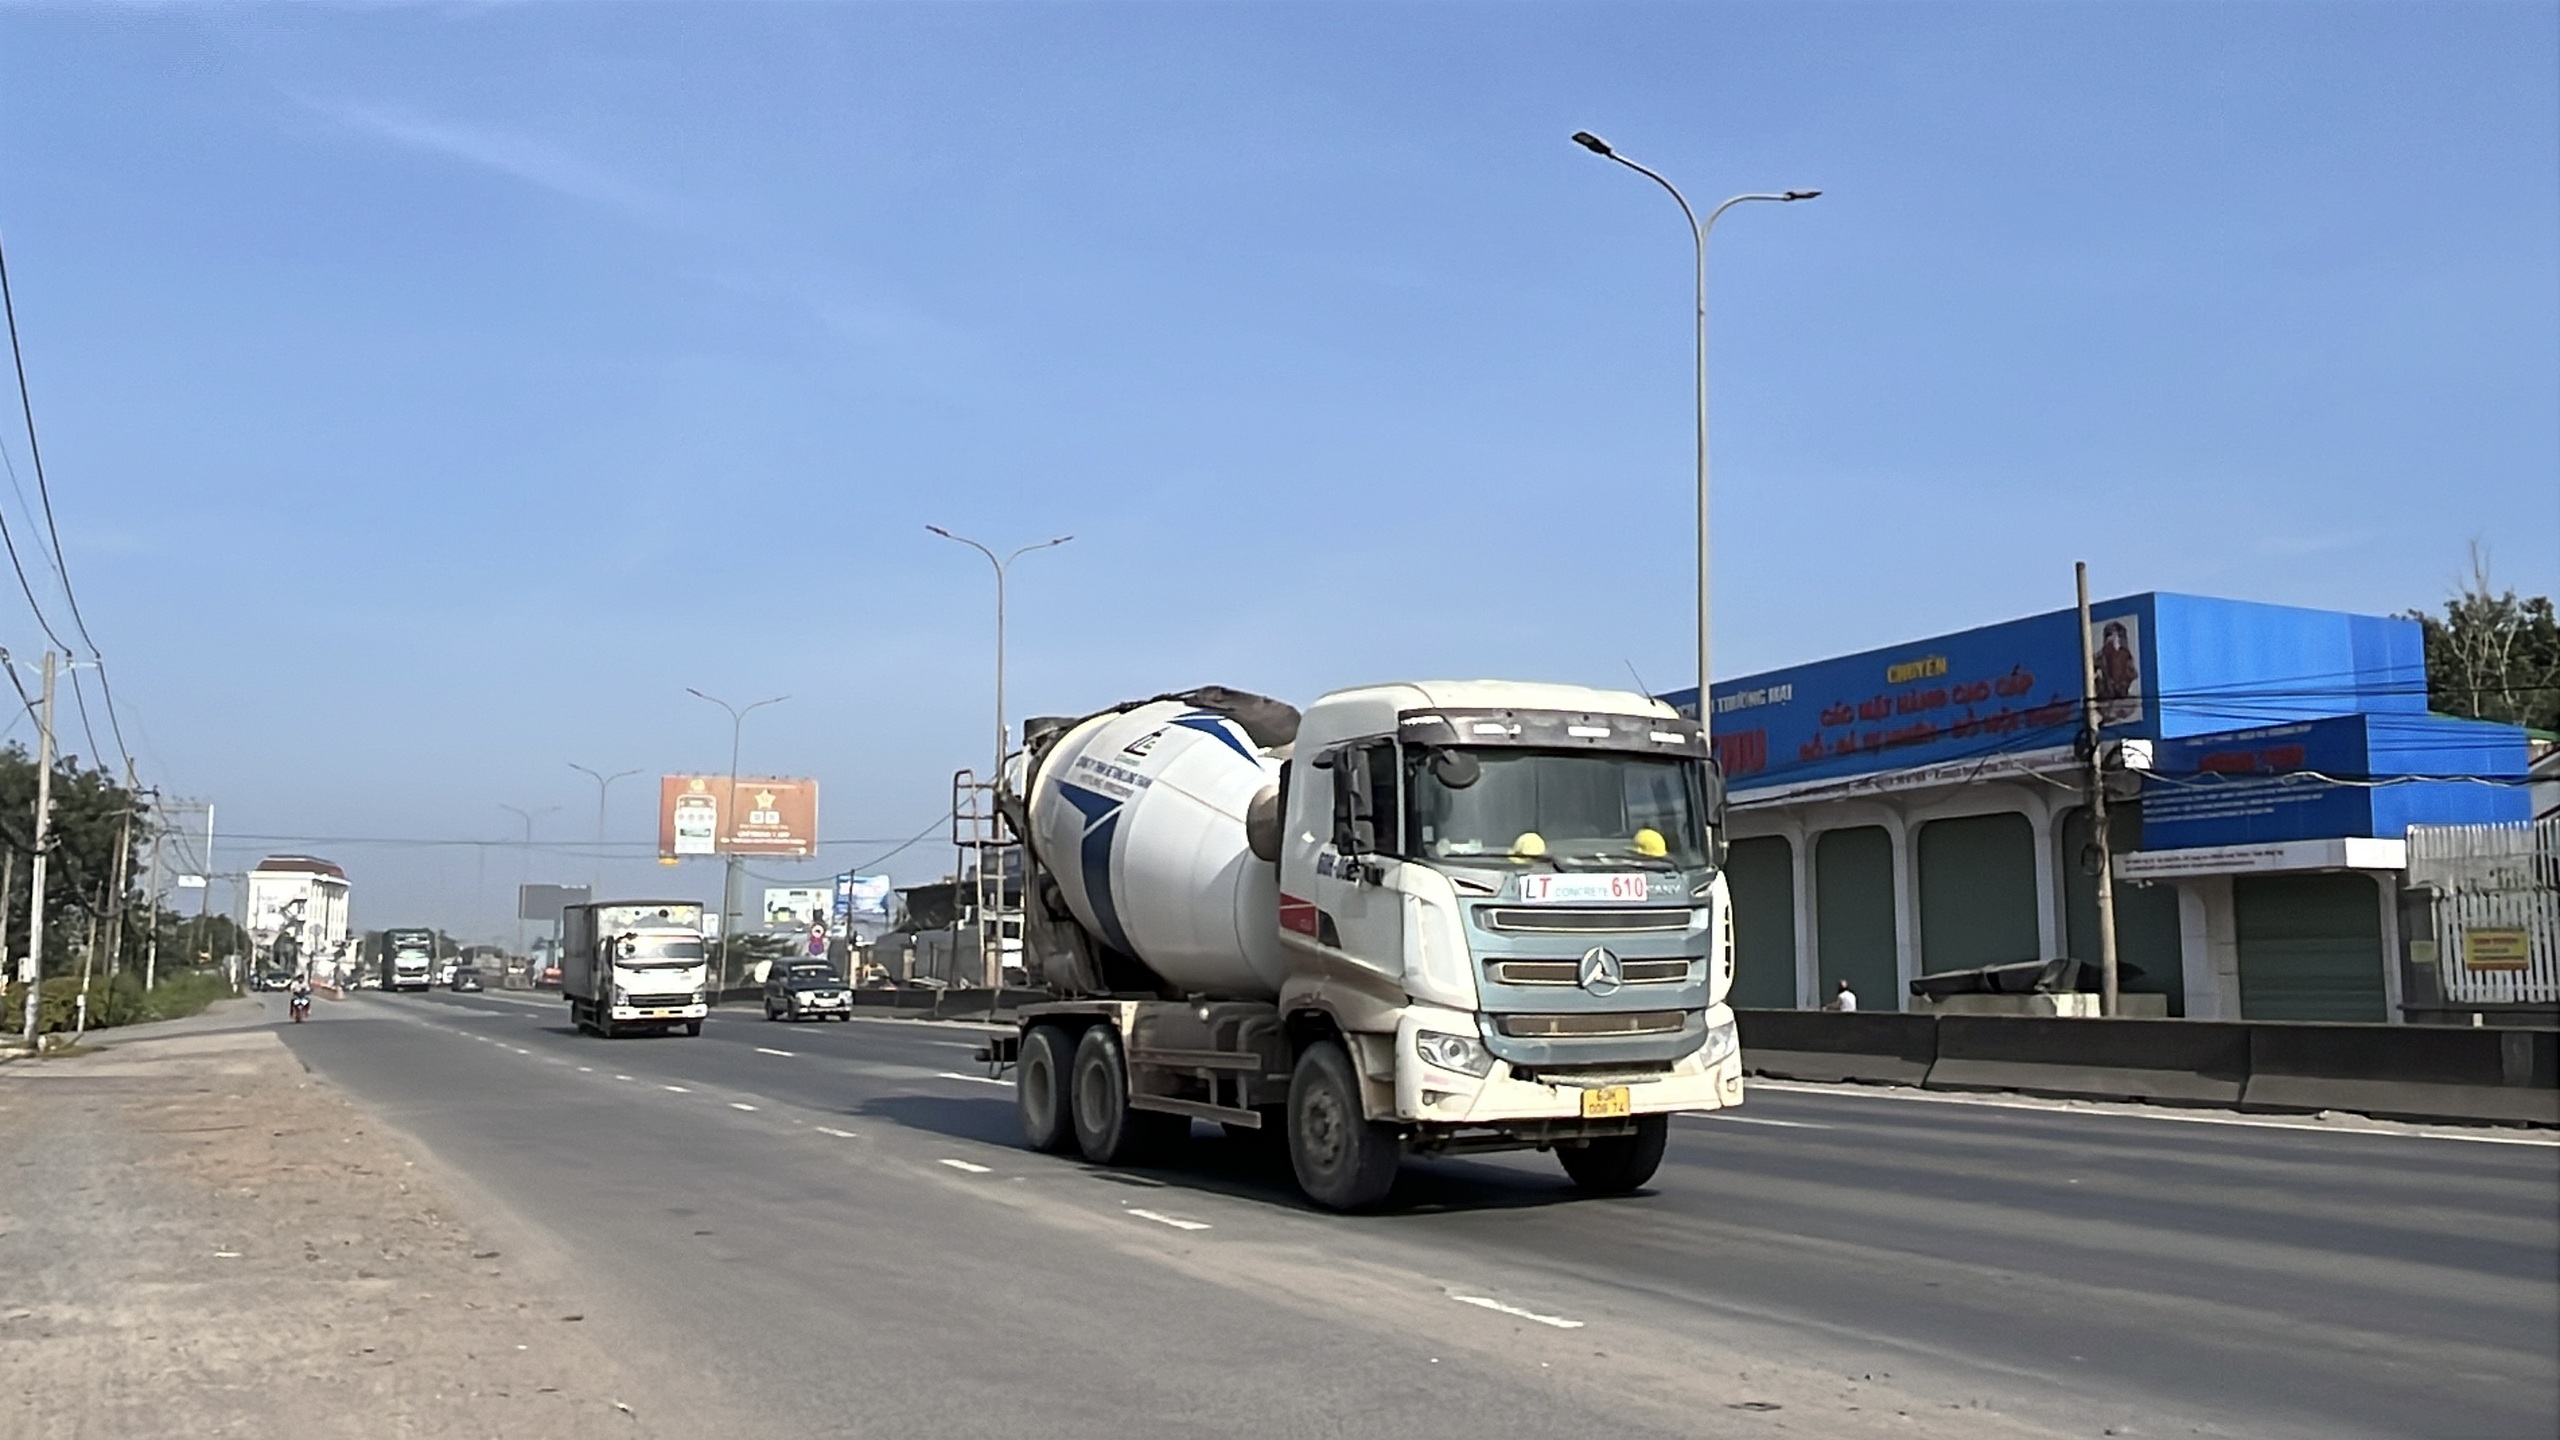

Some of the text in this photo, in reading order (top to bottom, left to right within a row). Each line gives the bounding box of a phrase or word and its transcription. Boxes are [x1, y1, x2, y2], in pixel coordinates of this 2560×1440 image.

[1525, 876, 1644, 899] LT CONCRETE 610
